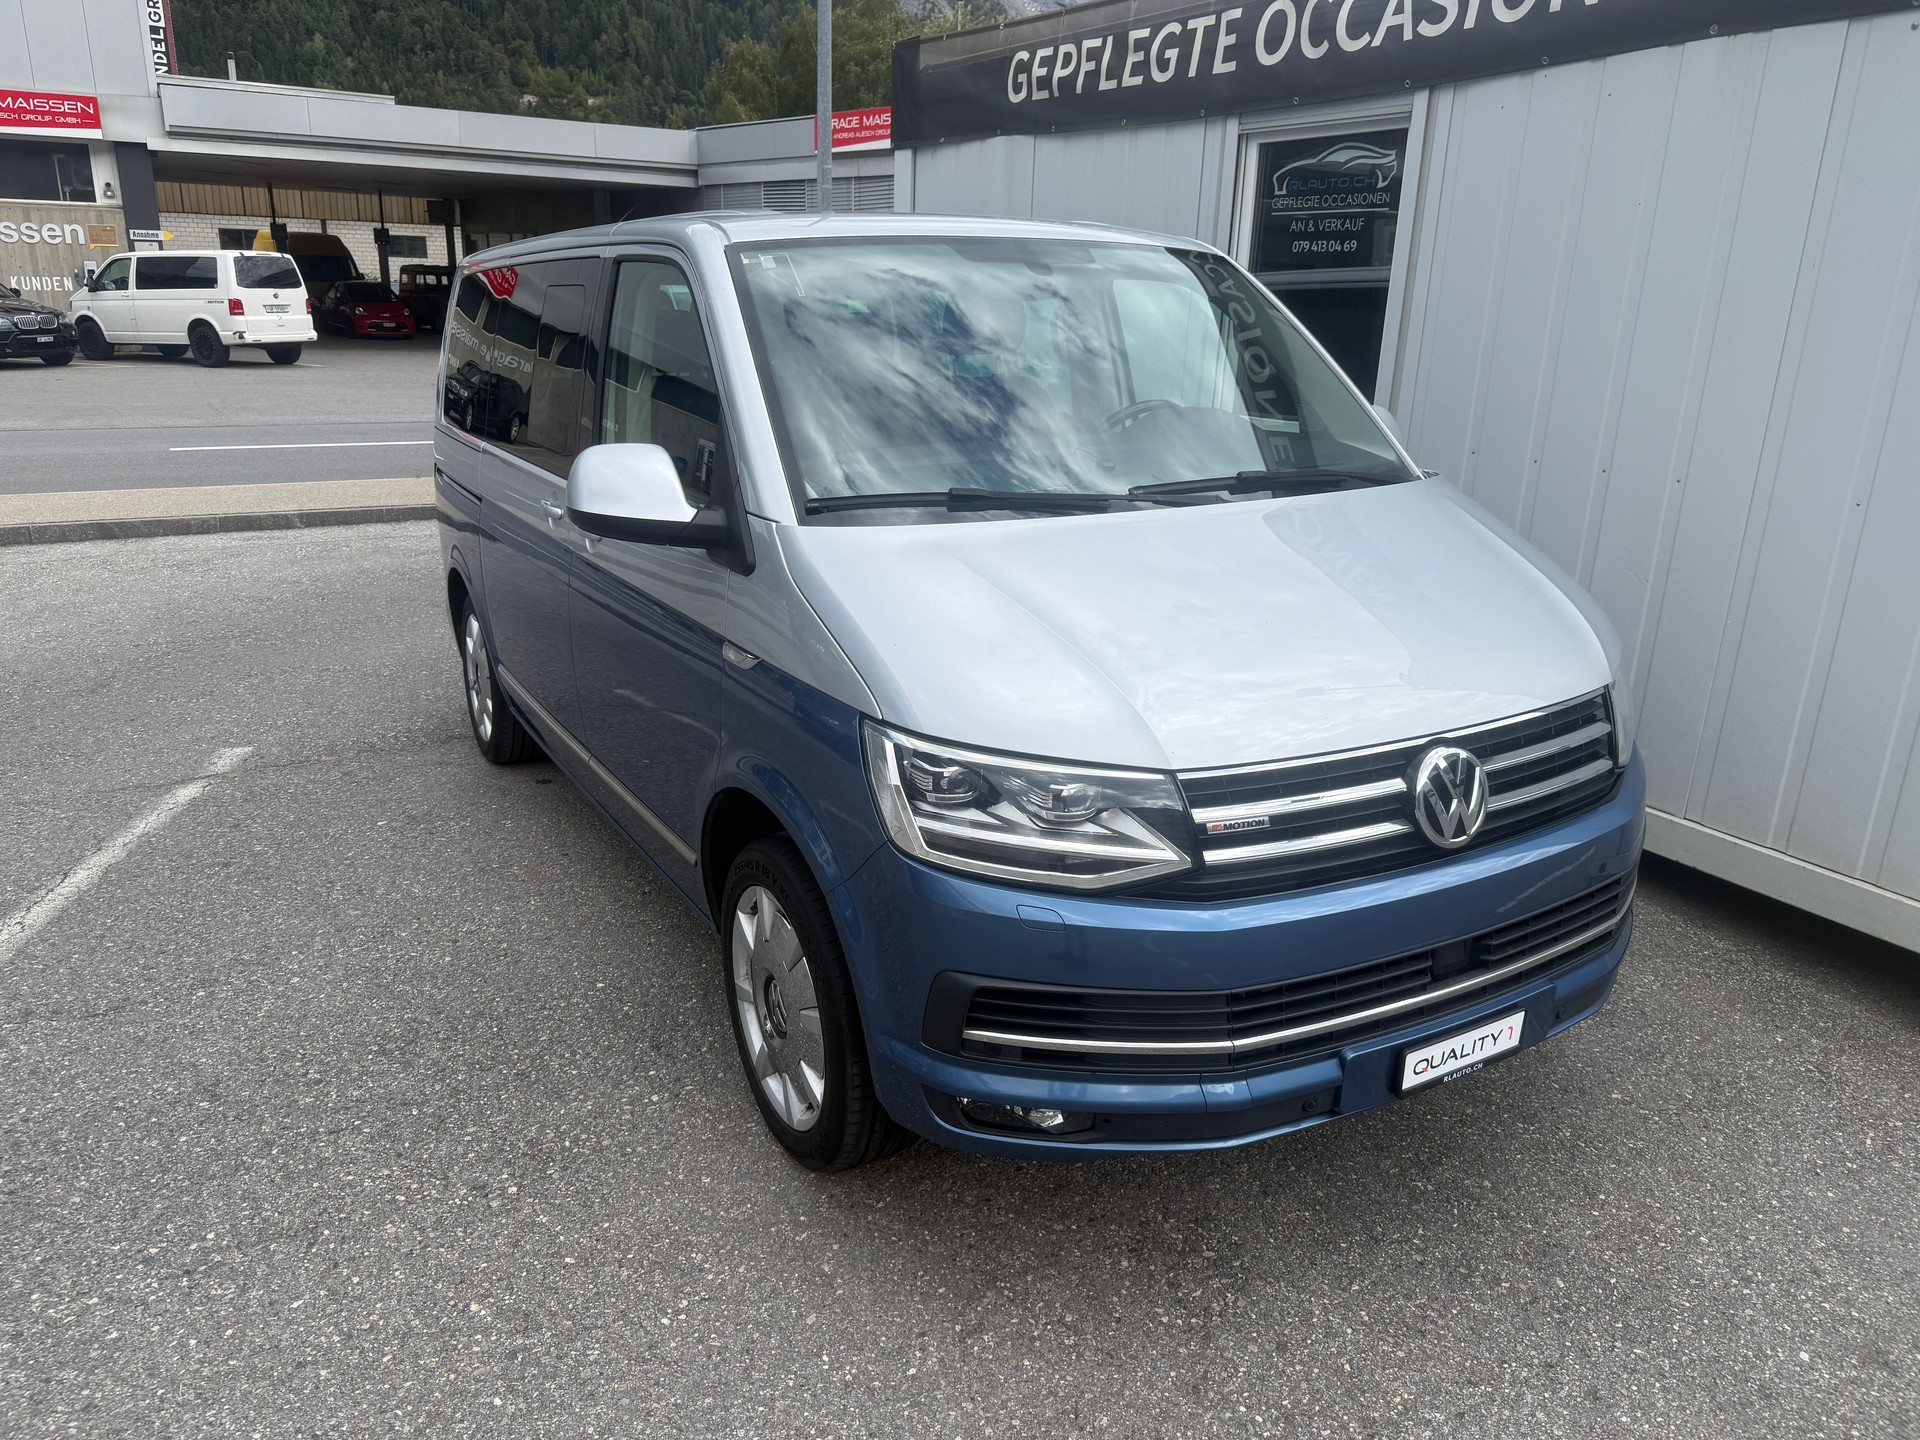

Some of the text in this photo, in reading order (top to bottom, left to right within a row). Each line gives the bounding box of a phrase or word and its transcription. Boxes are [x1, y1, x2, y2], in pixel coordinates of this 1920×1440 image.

[1007, 0, 1599, 104] GEPFLEGTE OCCAS
[21, 113, 52, 122] GROUP
[1289, 176, 1376, 191] RLAUTO.CH
[1271, 192, 1391, 209] GEPFLEGTE OCCASIONEN
[0, 221, 86, 245] ssen
[1289, 218, 1365, 233] AN & VERKAUF
[132, 230, 160, 239] Annahme
[1292, 239, 1357, 253] 079 413 04 69
[10, 275, 74, 292] KUNDEN
[1413, 1028, 1504, 1076] QUALITY
[1443, 1062, 1484, 1083] RLAUTO.CH
